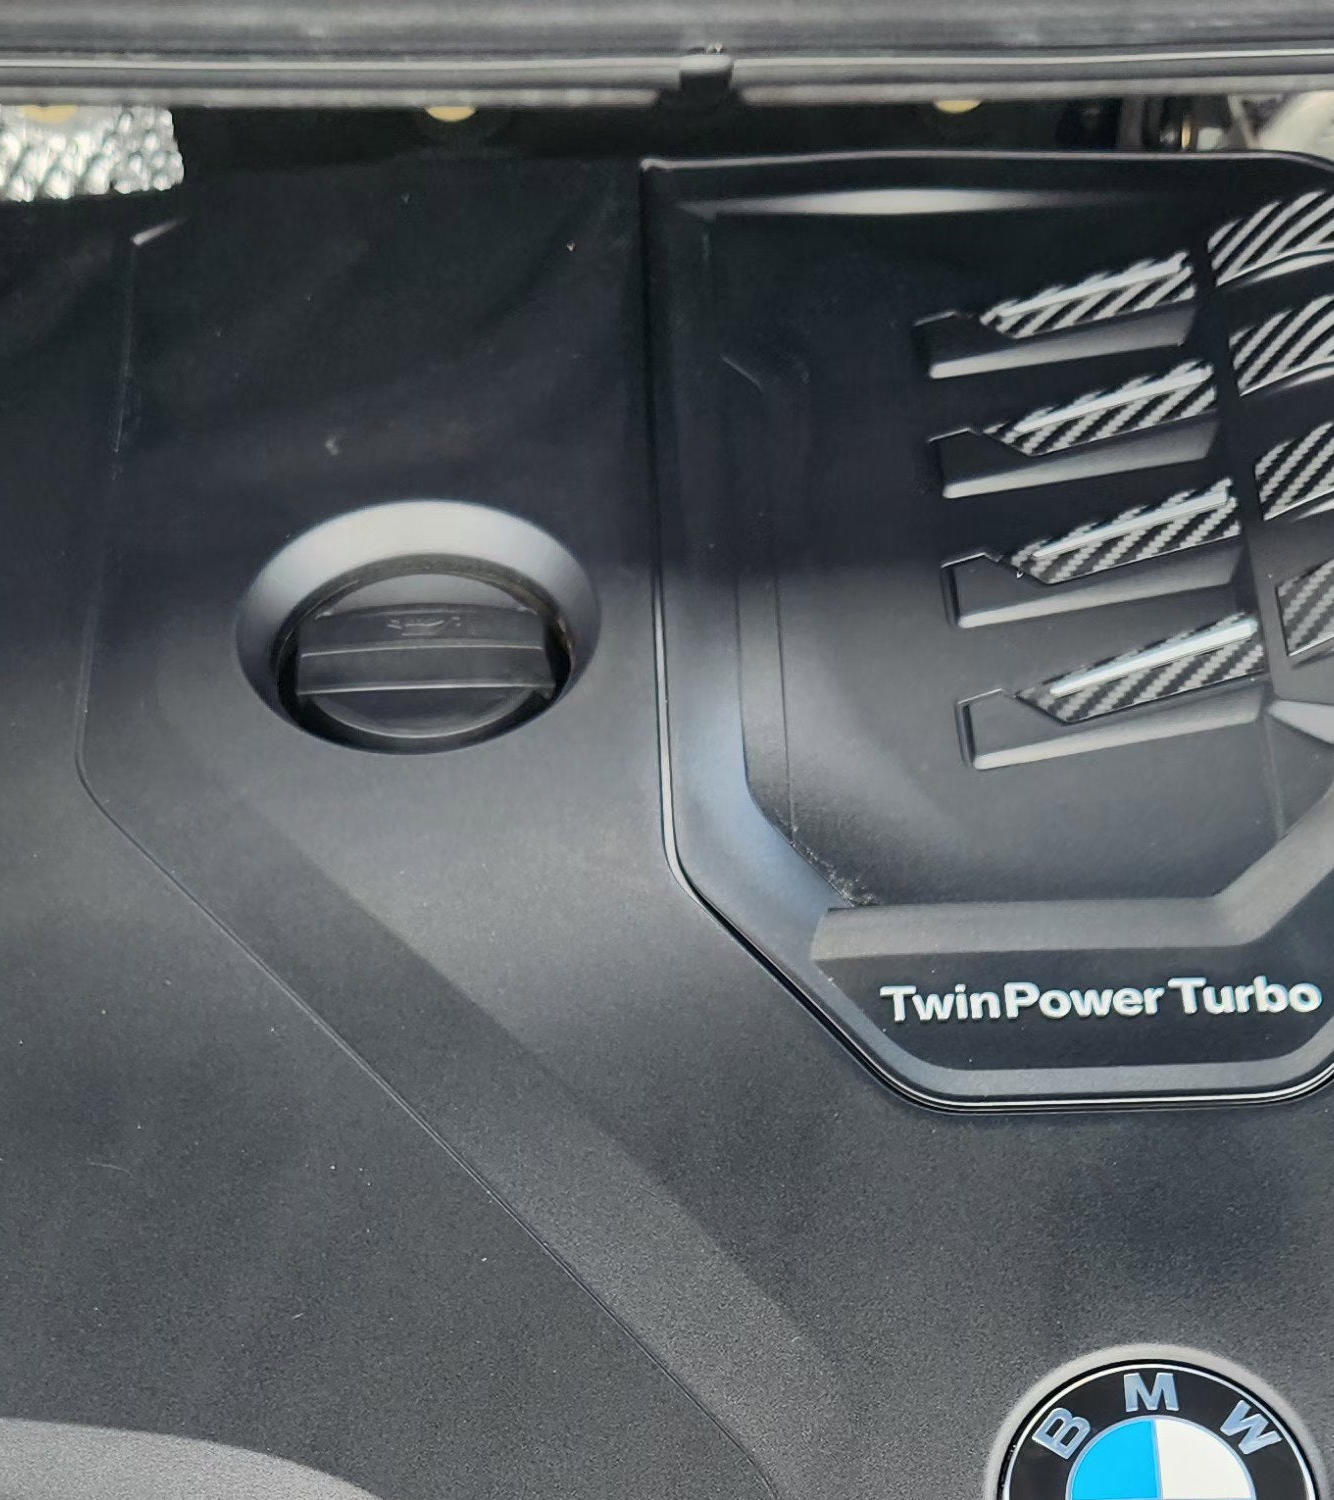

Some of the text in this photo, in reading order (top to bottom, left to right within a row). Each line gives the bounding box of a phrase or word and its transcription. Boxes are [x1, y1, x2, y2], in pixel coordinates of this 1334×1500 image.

[879, 975, 1323, 1022] TwinPower Turbo
[1032, 1372, 1282, 1460] BMW
